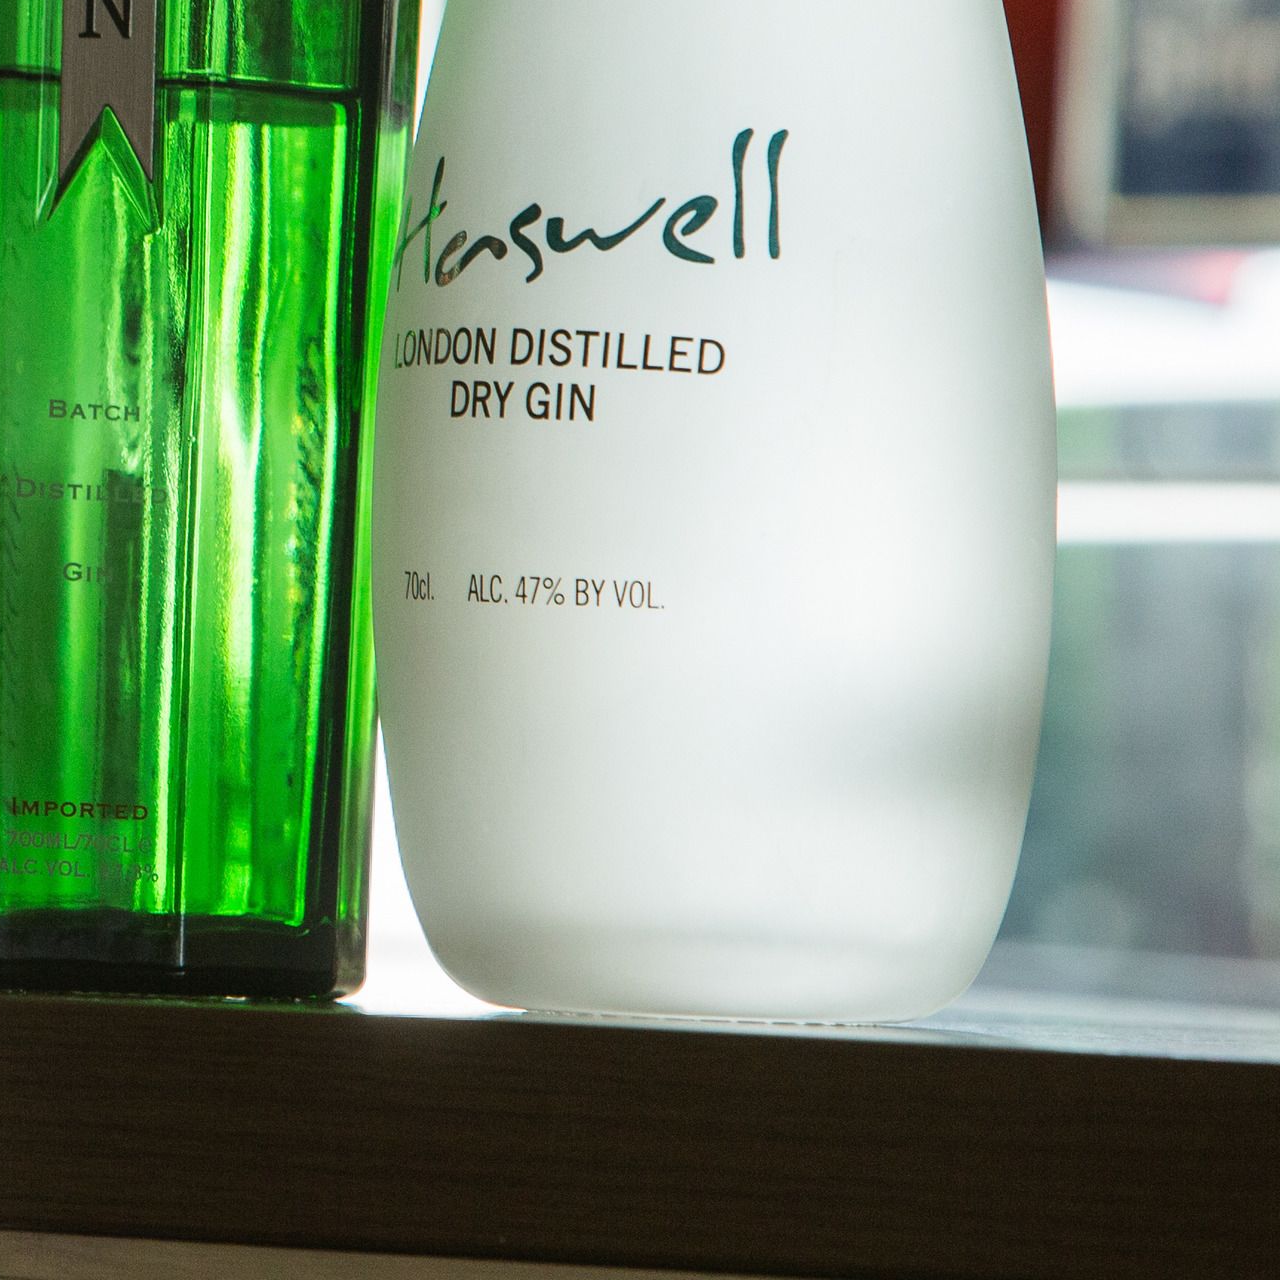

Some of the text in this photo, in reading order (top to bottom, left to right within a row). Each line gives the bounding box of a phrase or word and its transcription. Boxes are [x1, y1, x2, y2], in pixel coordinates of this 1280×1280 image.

[394, 326, 726, 375] LONDON DISTILLED
[48, 398, 141, 422] BATCH
[450, 379, 596, 421] DRY GIN
[404, 570, 666, 610] 70cl. ALC. 47% BY VOL.
[11, 796, 149, 821] IMPORTED
